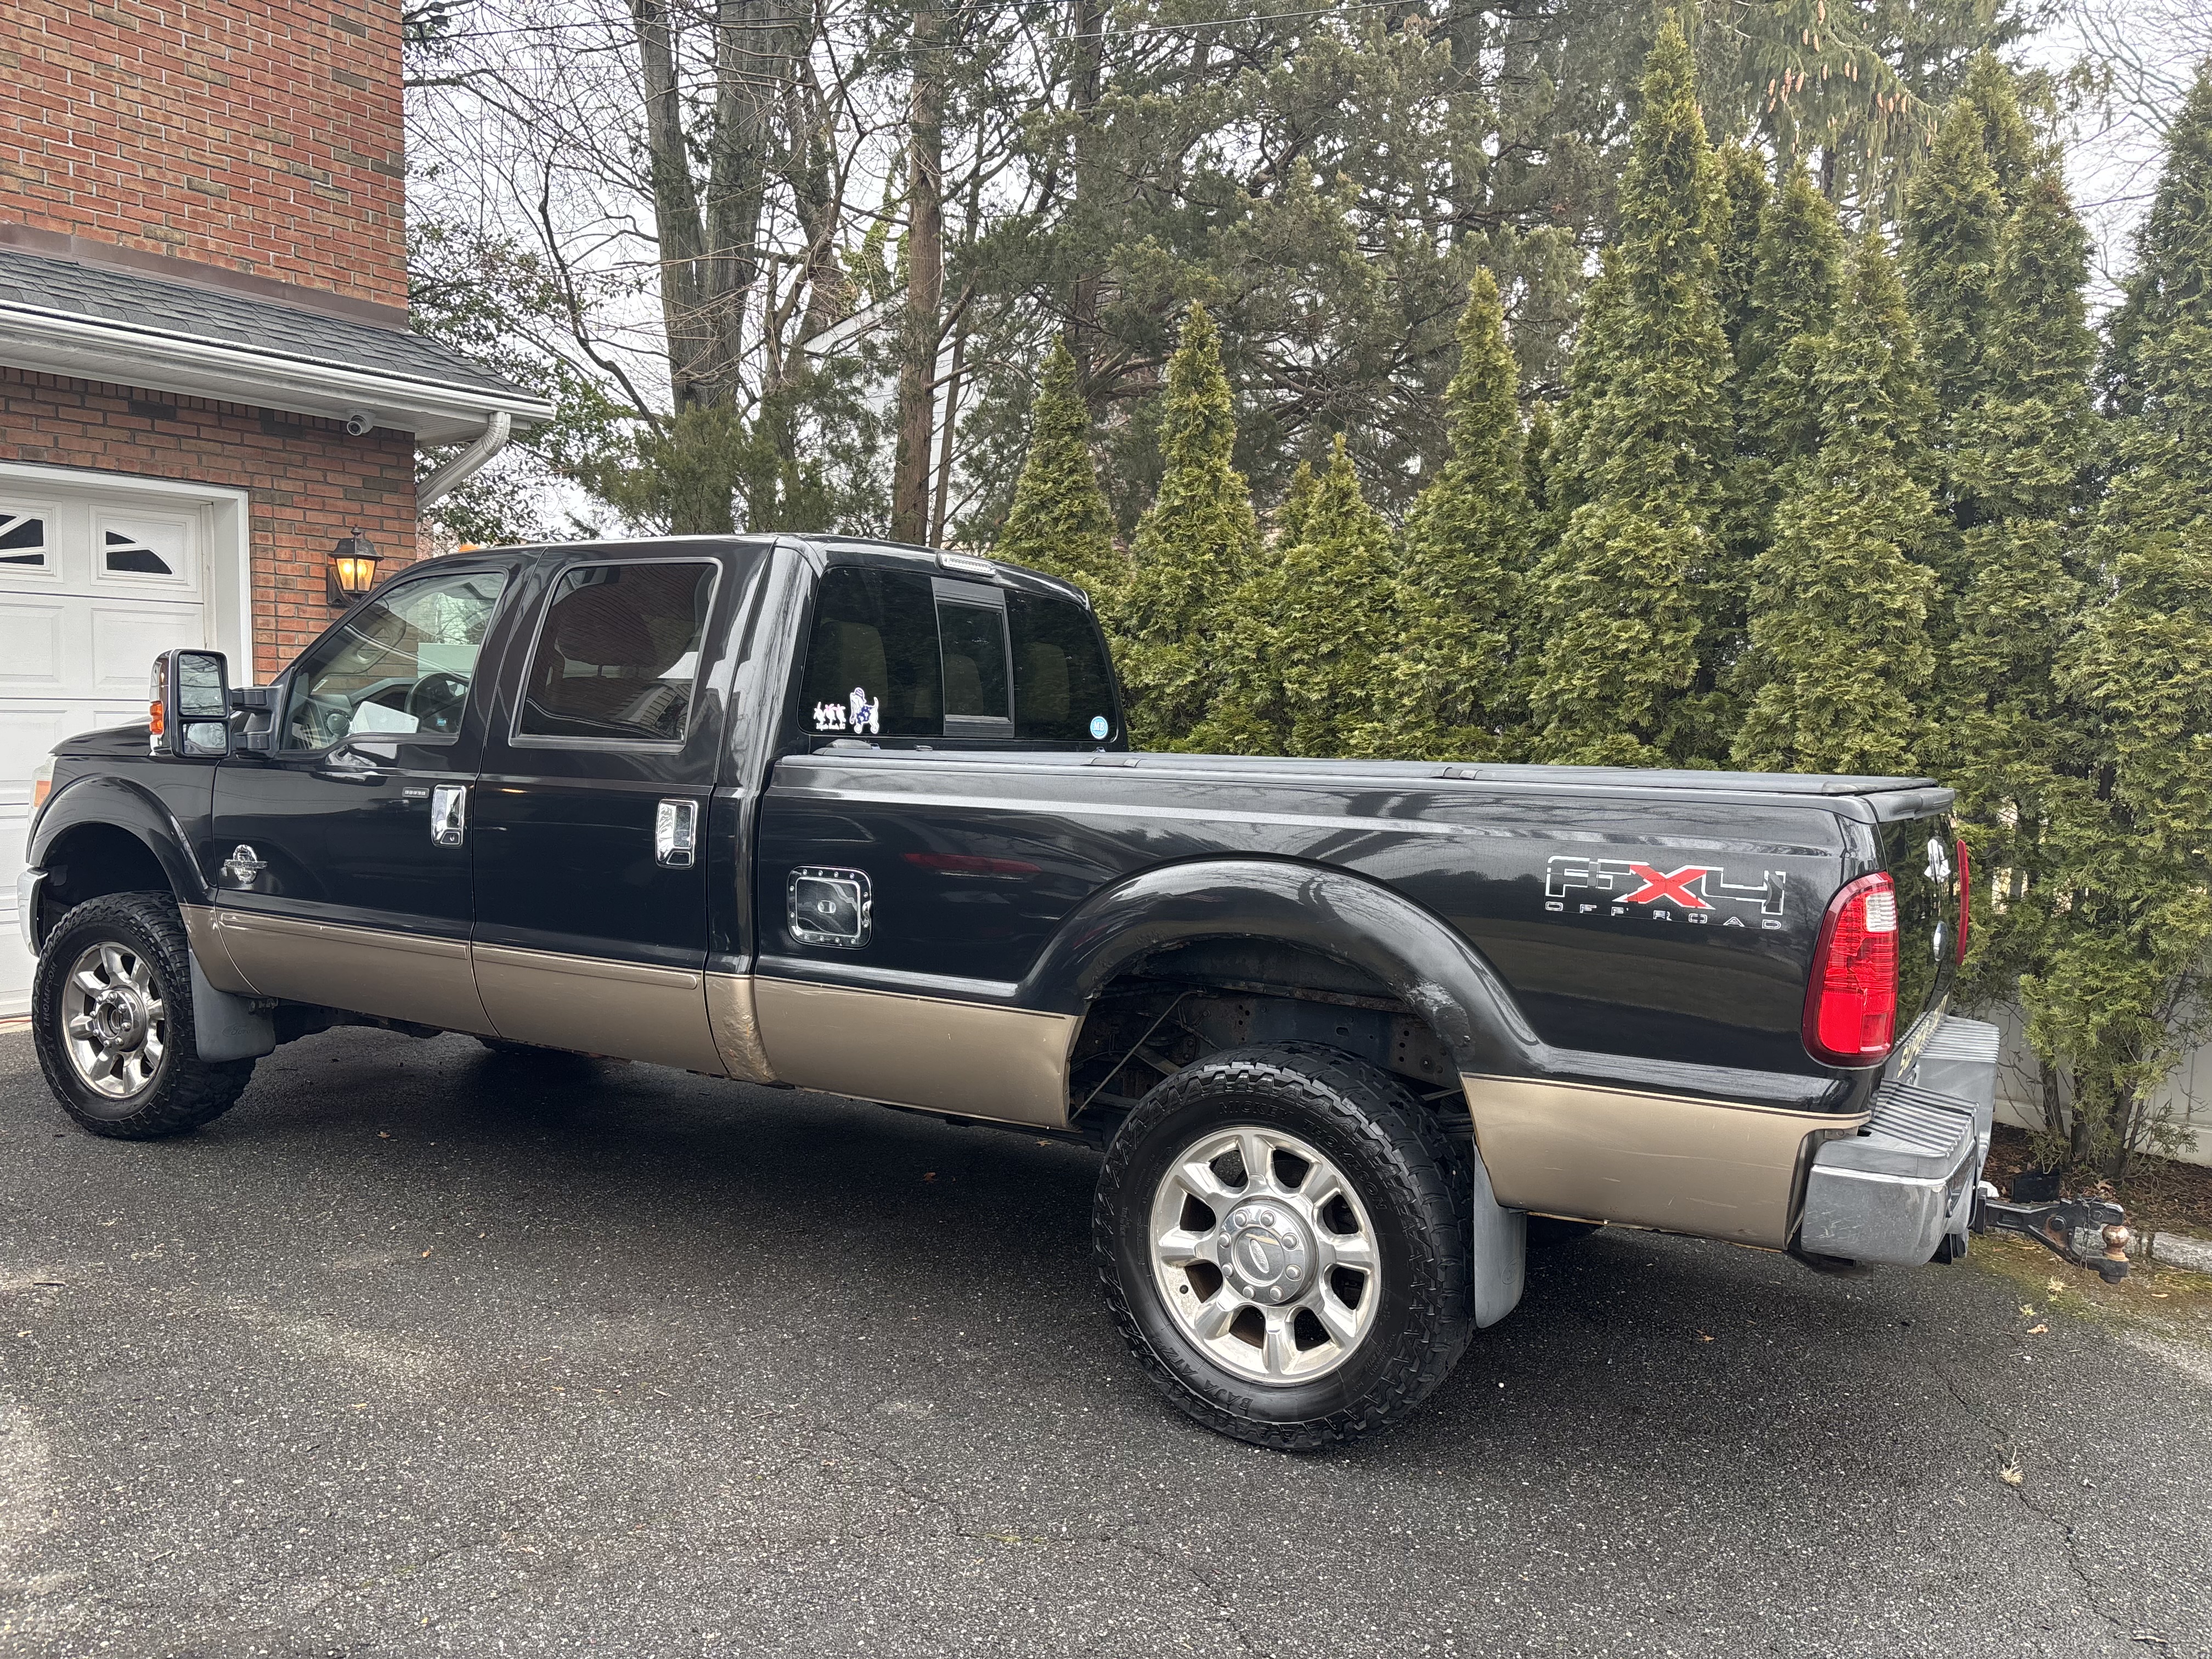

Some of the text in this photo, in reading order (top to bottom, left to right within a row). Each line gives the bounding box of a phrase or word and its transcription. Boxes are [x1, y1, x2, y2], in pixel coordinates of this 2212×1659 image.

[1093, 721, 1104, 731] MB
[1545, 855, 1786, 915] FX4
[1544, 901, 1782, 930] OFF ROAD
[43, 961, 59, 1028] THOMPSON
[1218, 1100, 1388, 1210] MICKEY THOMPSON
[1203, 1378, 1254, 1411] BAJA
